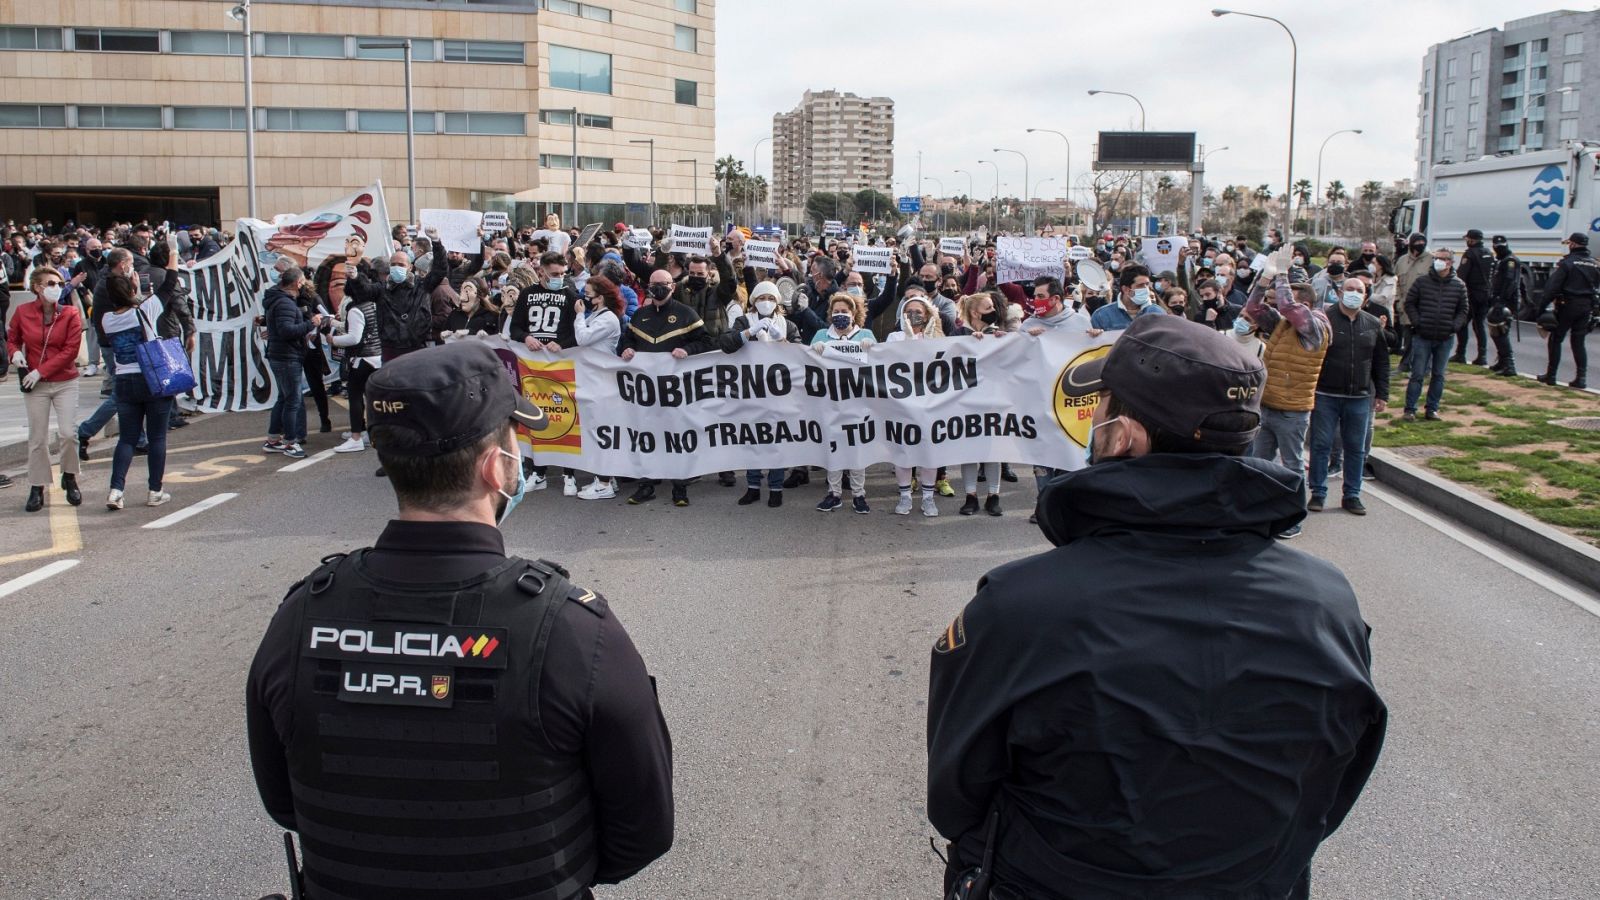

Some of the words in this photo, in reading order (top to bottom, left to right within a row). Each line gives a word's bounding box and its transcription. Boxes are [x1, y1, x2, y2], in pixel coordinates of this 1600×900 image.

[674, 230, 708, 239] ARMENGOL
[675, 240, 706, 249] DIMISIÓN
[857, 259, 887, 268] DIMISIÓN
[527, 292, 567, 303] COMPTON
[528, 305, 561, 333] 90
[616, 363, 792, 408] GOBIERNO
[804, 351, 978, 402] DIMISIÓN
[1226, 386, 1258, 400] CNP
[372, 400, 404, 413] CNP
[597, 425, 620, 450] SI
[627, 427, 656, 454] YO
[664, 429, 698, 454] NO
[842, 415, 875, 447] TÚ
[885, 420, 922, 446] NO
[931, 412, 1038, 445] COBRAS
[310, 626, 465, 658] POLICIA
[343, 671, 427, 696] U.P.R.
